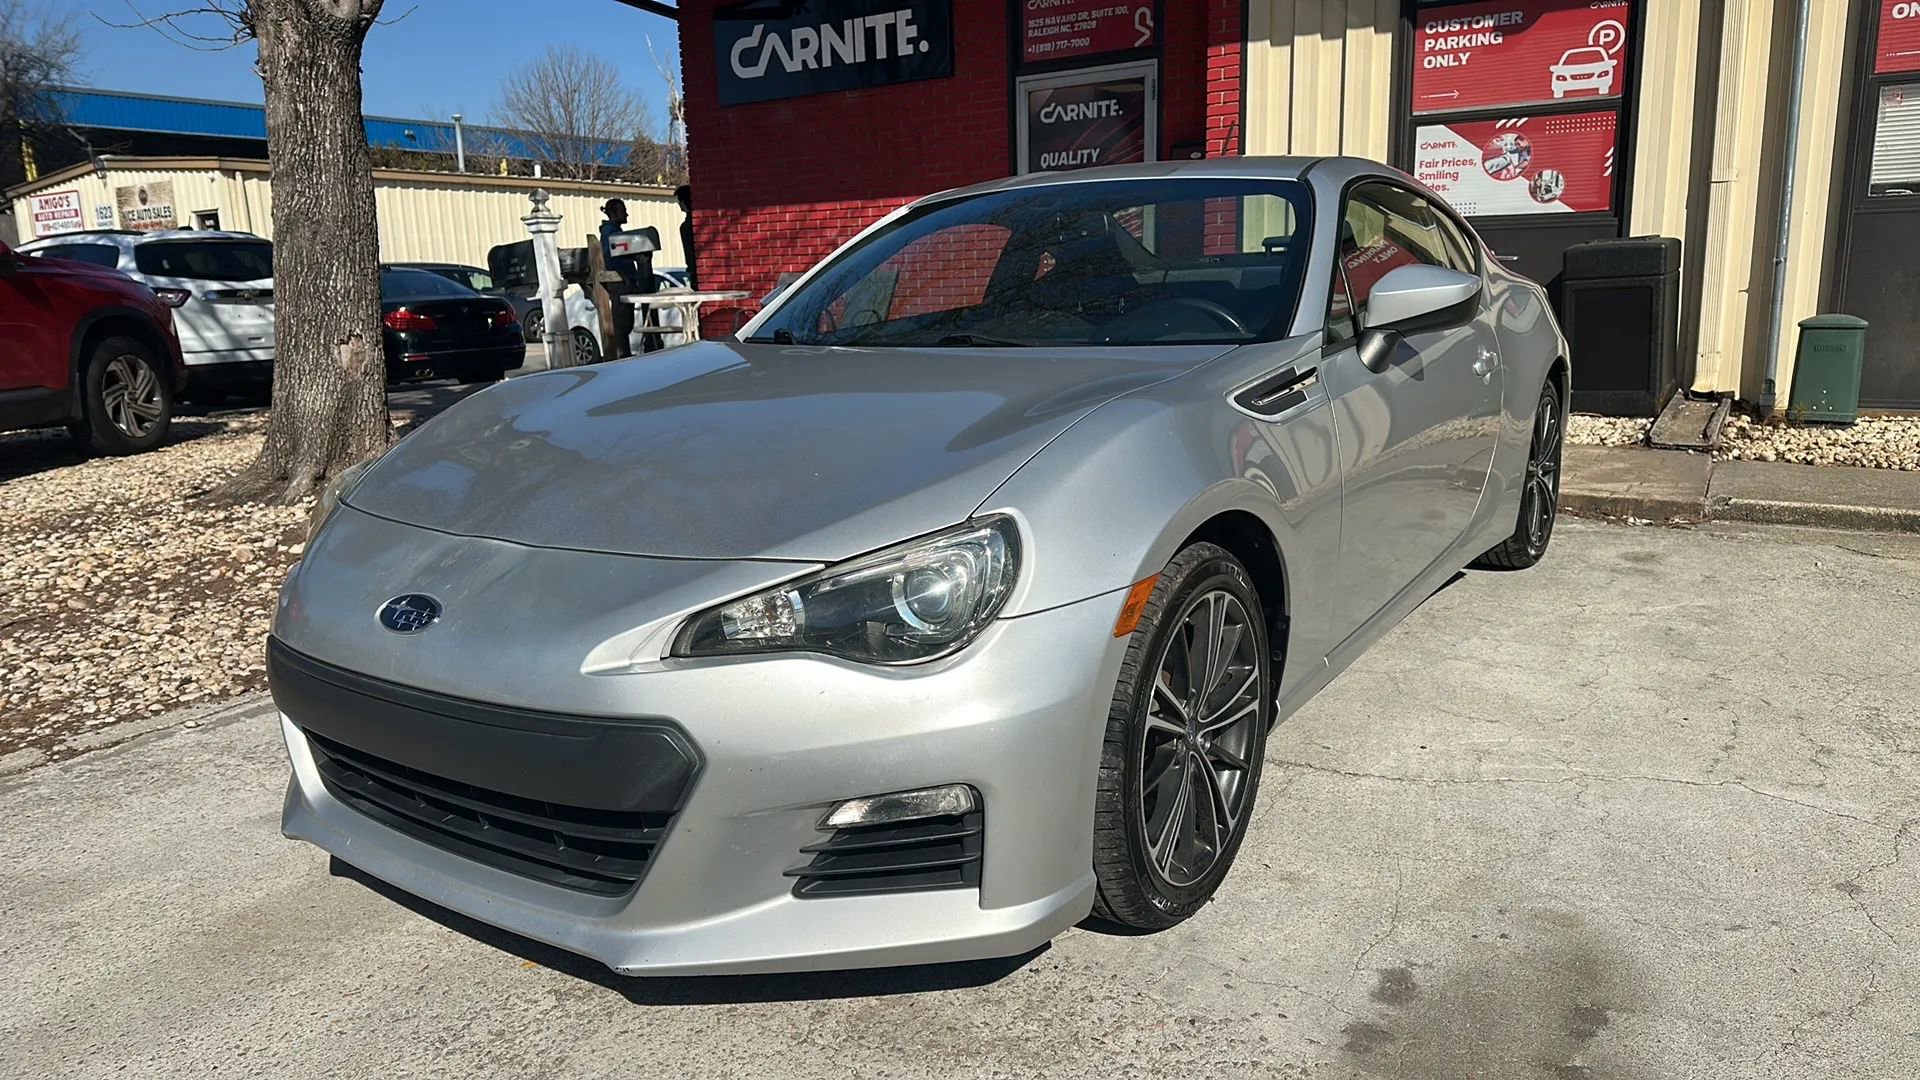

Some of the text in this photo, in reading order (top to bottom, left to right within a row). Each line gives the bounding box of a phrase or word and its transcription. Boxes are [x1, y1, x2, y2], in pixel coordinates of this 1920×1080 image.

[1045, 14, 1077, 26] NAVAHO
[1091, 8, 1113, 18] SUITE
[1892, 2, 1920, 19] ON
[1425, 11, 1524, 34] CUSTOMER
[1028, 26, 1059, 37] RALEIGH
[731, 9, 929, 79] CARNITE.
[1424, 31, 1504, 52] PARKING
[1423, 52, 1472, 69] ONLY
[1040, 148, 1100, 169] QUALITY
[1419, 157, 1477, 169] Fair Prices,
[1419, 170, 1459, 182] Smiling
[1426, 183, 1450, 192] des.
[38, 195, 71, 210] AMIGO'S
[95, 205, 113, 220] 1623
[136, 207, 152, 221] AUTO
[152, 205, 172, 219] SALES
